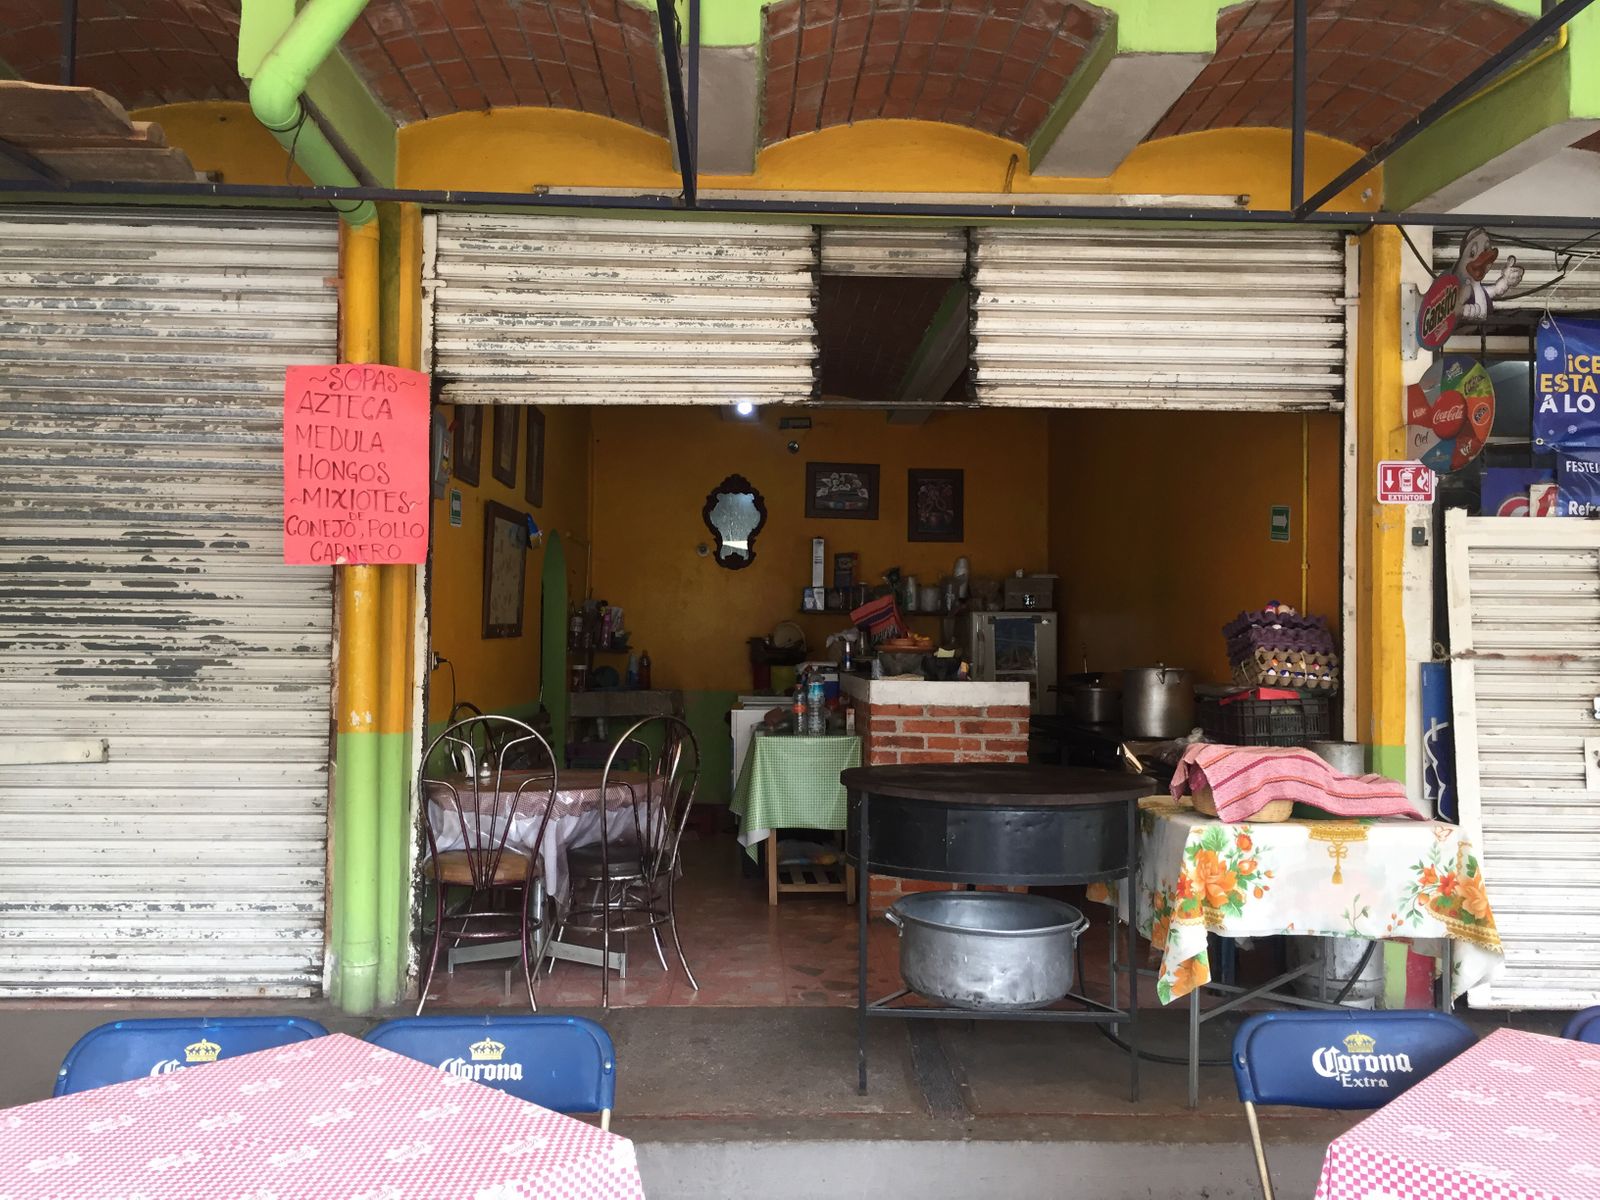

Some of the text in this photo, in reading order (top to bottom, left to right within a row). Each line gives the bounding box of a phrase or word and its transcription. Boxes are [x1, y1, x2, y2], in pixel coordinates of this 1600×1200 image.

[328, 367, 399, 392] SOPAS
[1540, 373, 1598, 394] ESTA
[296, 390, 393, 420] AZTECA
[1539, 394, 1596, 413] A LO
[295, 424, 385, 453] MEDULA
[1414, 432, 1429, 447] Ciel
[297, 453, 391, 485] HONGOS
[302, 487, 411, 514] MIXIOTES
[1388, 494, 1425, 502] EXTINTOR
[348, 511, 364, 521] DE
[368, 518, 425, 539] POLLO
[310, 541, 402, 562] CARNERO
[1311, 1046, 1414, 1082] Corona
[1341, 1073, 1389, 1088] Extra
